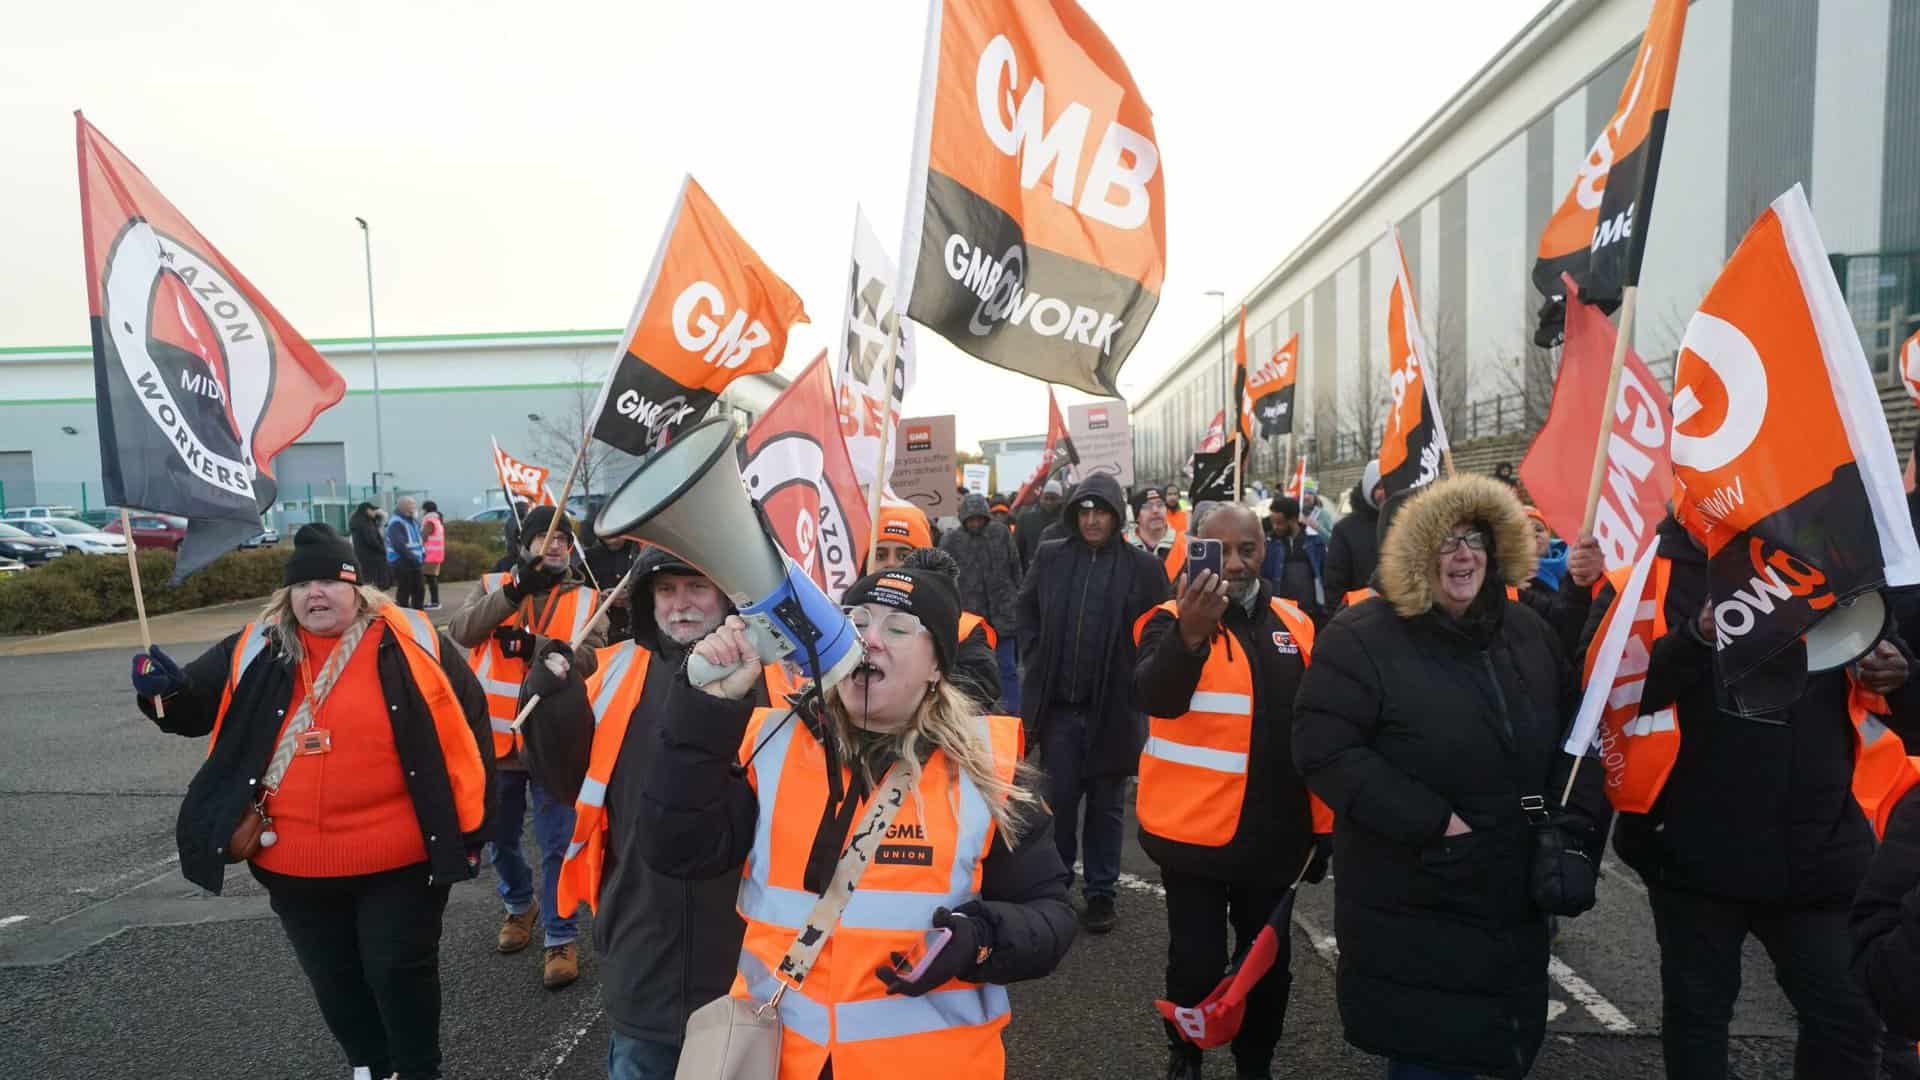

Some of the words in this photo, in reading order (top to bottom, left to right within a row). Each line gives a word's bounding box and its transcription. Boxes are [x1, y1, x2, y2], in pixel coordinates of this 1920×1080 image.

[975, 33, 1160, 231] GMB
[671, 280, 771, 369] GMB
[136, 370, 250, 491] WORKERS
[882, 850, 926, 860] UNION
